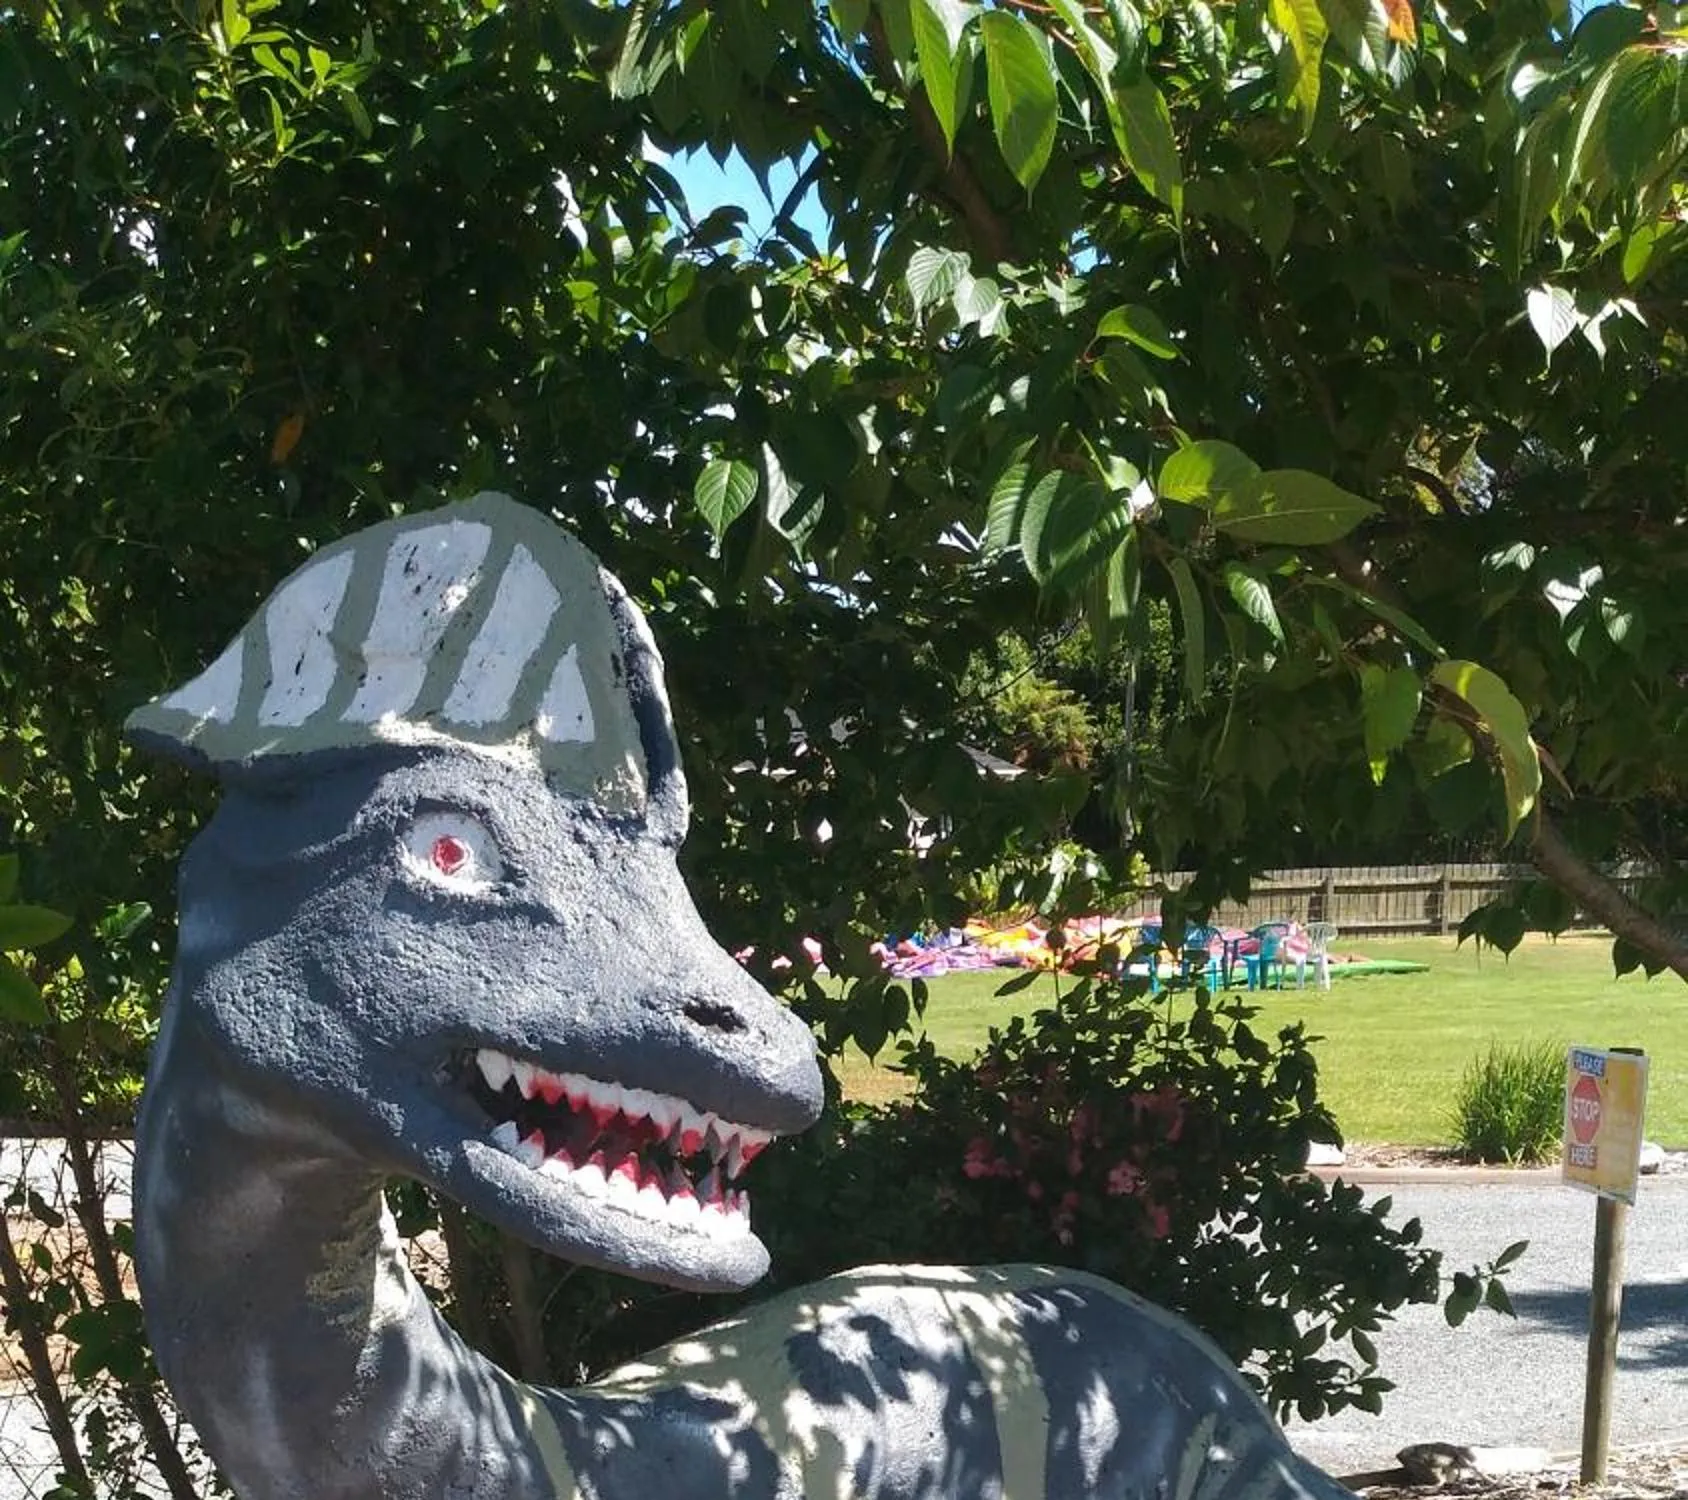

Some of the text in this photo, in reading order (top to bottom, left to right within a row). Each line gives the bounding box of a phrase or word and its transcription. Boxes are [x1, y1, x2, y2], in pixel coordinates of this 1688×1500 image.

[1575, 1053, 1603, 1075] PLEASE
[1574, 1097, 1599, 1121] STOP
[1571, 1146, 1595, 1166] HERE
